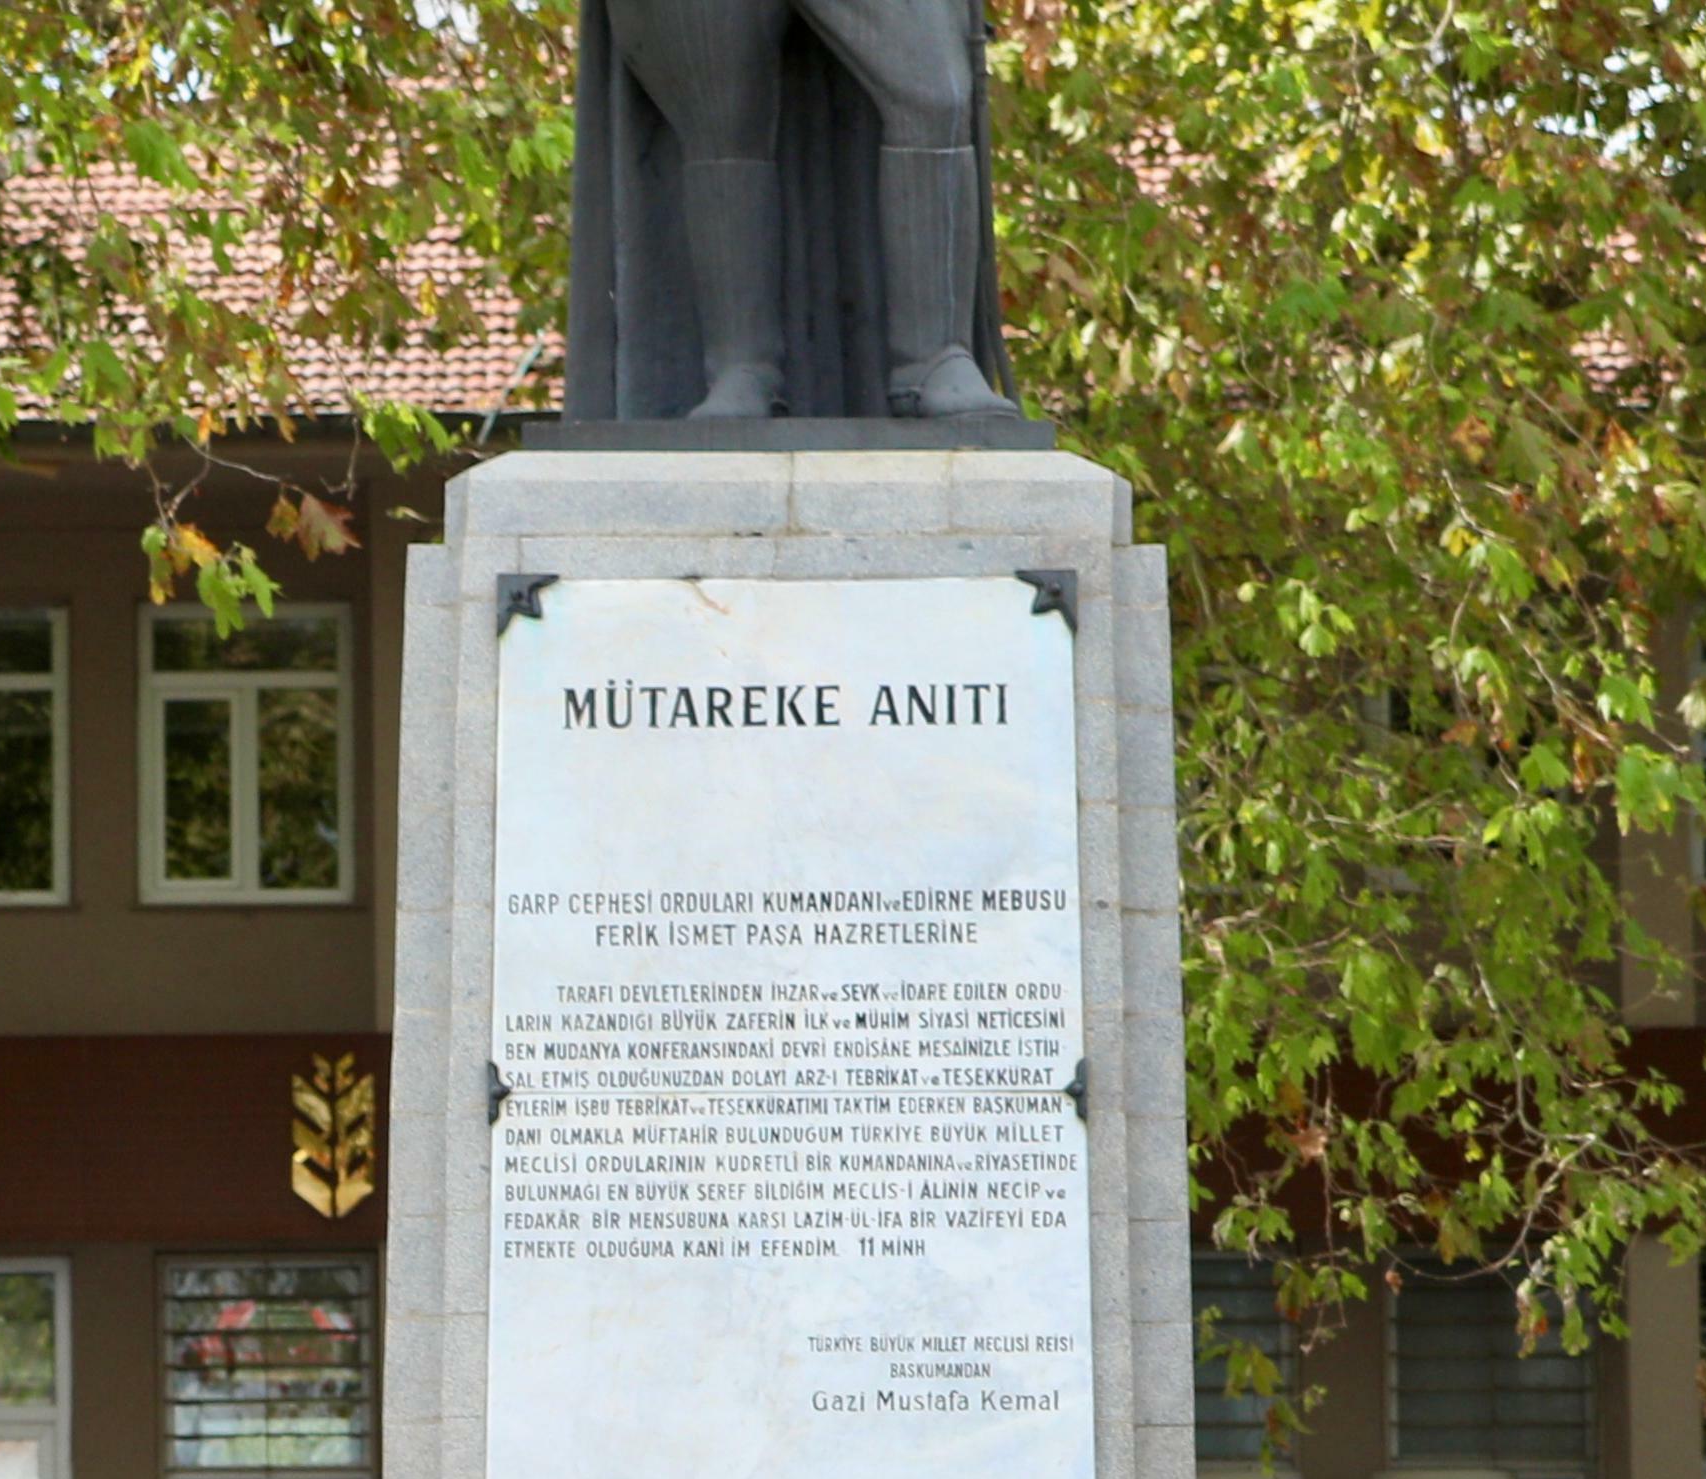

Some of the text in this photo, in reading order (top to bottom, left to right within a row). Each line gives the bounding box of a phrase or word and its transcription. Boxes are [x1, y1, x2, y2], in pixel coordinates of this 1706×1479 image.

[562, 679, 1009, 730] MÜTAREKE ANITI
[508, 893, 559, 915] GARP
[569, 890, 653, 914] CEPHESİ
[660, 892, 754, 914] ORDULARI
[763, 891, 882, 913] KUMANDANI
[903, 887, 973, 912] EDİRNE
[982, 889, 1067, 911] MEBUSU
[596, 921, 660, 946] FERİK
[669, 920, 737, 946] İSMET
[815, 919, 978, 945] HAZRETLERİNE
[557, 985, 614, 1002] TARAFI
[620, 981, 763, 1002] DEVLETLERİNDEN
[771, 980, 819, 1001] İHZAR
[821, 989, 838, 1001] ve
[841, 984, 880, 1001] SEVK
[901, 979, 947, 1001] İDARE
[505, 1015, 552, 1033] LARIN
[661, 1009, 718, 1031] BÜYÜK
[725, 1008, 796, 1031] ZAFERİN
[804, 1007, 828, 1030] İLK
[832, 1017, 851, 1030] ve
[855, 1007, 910, 1030] MÜHİM
[918, 1007, 969, 1030] SİYASİ
[977, 1006, 1066, 1029] NETİCESİNİ
[505, 1043, 536, 1061] BEN
[544, 1042, 621, 1060] MUDANYA
[628, 1037, 775, 1060] KONFERANSINDAKİ
[782, 1036, 827, 1058] DEVRİ
[505, 1071, 536, 1089] SAL
[597, 1067, 725, 1087] OLDUĞUNUZDAN
[732, 1069, 786, 1087] DOLAYI
[921, 1074, 940, 1086] ve
[505, 1096, 567, 1117] EYLERİM
[834, 1094, 891, 1115] TAKTİM
[898, 1097, 966, 1115] EDERKEN
[505, 1127, 542, 1146] DANI
[550, 1127, 624, 1145] OLMAKLA
[632, 1125, 718, 1145] MÜFTAHİR
[851, 1123, 923, 1143] TÜRKİYE
[930, 1123, 988, 1143] BÜYÜK
[995, 1122, 1064, 1143] MİLLET
[504, 1153, 578, 1173] MECLİSİ
[585, 1155, 706, 1173] ORDULARININ
[715, 1151, 798, 1172] KUDRETLİ
[806, 1150, 832, 1172] BİR
[840, 1154, 955, 1172] KUMANDANINA
[975, 1150, 1078, 1172] RİYASETİNDE
[608, 1184, 629, 1201] EN
[635, 1181, 689, 1201] BÜYÜK
[987, 1180, 1041, 1199] NECİP
[1045, 1187, 1066, 1199] ve
[593, 1208, 621, 1229] BİR
[629, 1211, 730, 1229] MENSUBUNA
[910, 1207, 936, 1228] BİR
[946, 1207, 1024, 1228] VAZİFEYİ
[1031, 1210, 1067, 1227] EDA
[504, 1241, 576, 1258] ETMEKTE
[807, 1335, 862, 1352] TÜRKİYE
[812, 1389, 1059, 1412] Gazi Mustafa Kemal
